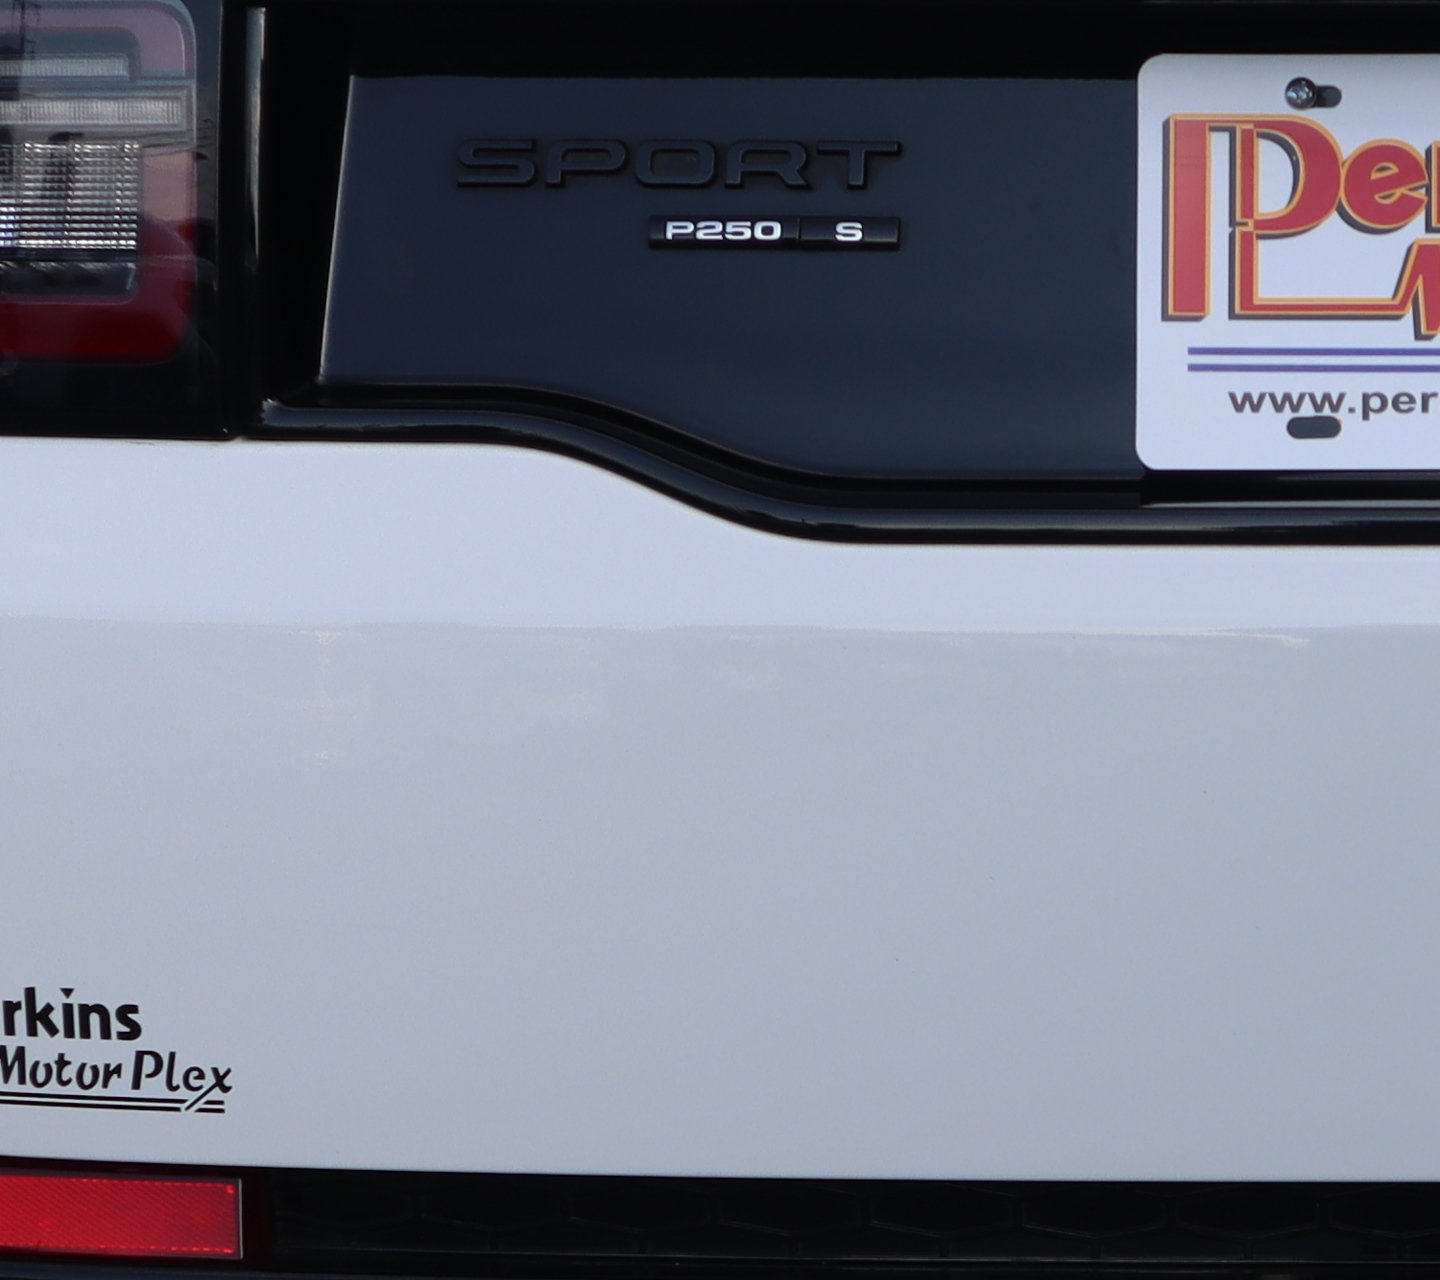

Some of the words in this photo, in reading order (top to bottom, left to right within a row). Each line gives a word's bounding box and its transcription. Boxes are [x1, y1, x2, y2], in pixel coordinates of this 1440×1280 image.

[456, 138, 903, 190] SPORT
[665, 220, 783, 242] P250
[834, 221, 864, 243] S
[130, 1050, 233, 1112] Plex
